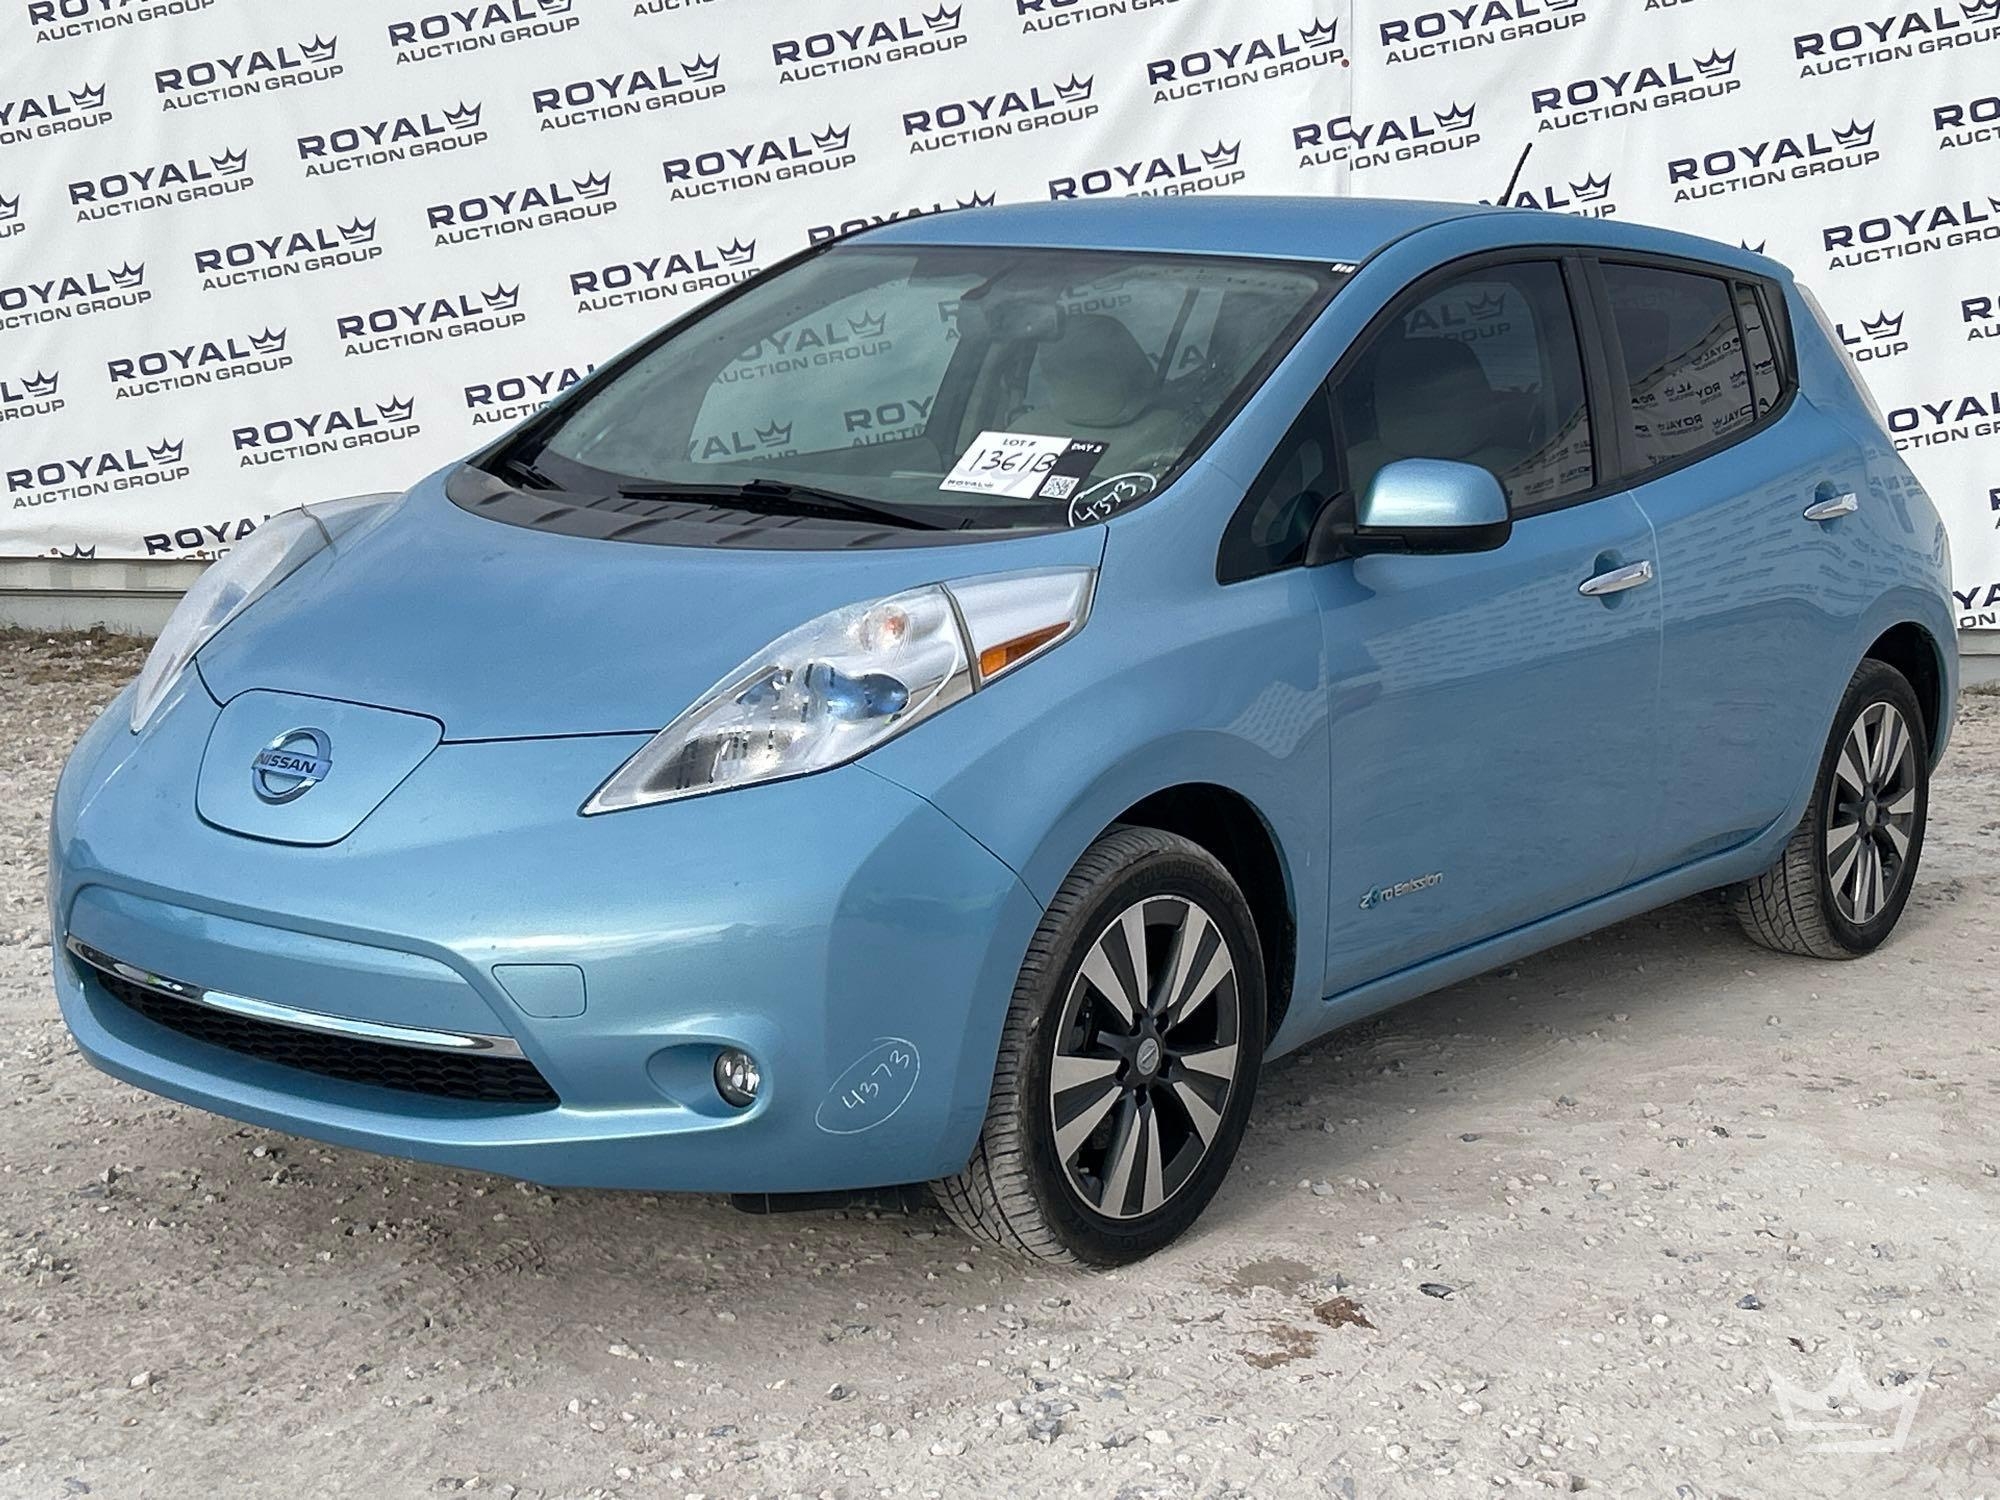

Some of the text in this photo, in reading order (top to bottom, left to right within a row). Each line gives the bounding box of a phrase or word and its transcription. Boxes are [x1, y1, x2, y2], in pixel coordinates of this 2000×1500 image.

[37, 12, 133, 43] AUCTION
[388, 0, 537, 47] ROYAL
[1023, 1, 1126, 34] AUCTION
[1380, 0, 1540, 46] ROYAL
[1386, 13, 1586, 65] AUCTION GROUP
[1794, 7, 1960, 59] ROYAL
[397, 17, 579, 65] AUCTION GROUP
[772, 17, 923, 66] ROYAL
[780, 35, 967, 84] AUCTION GROUP
[1147, 33, 1300, 85] ROYAL
[1800, 45, 1912, 78] AUCTION
[155, 47, 301, 93] ROYAL
[163, 65, 343, 111] AUCTION GROUP
[533, 66, 682, 113] ROYAL
[1154, 49, 1343, 104] AUCTION GROUP
[1532, 62, 1694, 114] ROYAL
[0, 95, 71, 126] YAL
[37, 112, 112, 137] GROUP
[541, 84, 725, 131] AUCTION GROUP
[903, 87, 1055, 136] ROYAL
[1538, 80, 1741, 133] AUCTION GROUP
[297, 114, 445, 159] ROYAL
[910, 105, 1098, 154] AUCTION GROUP
[1299, 133, 1480, 171] AUCION GROUP
[1940, 126, 2000, 150] AUCT
[306, 132, 488, 177] AUCTION GROUP
[663, 137, 812, 183] ROYAL
[1049, 153, 1201, 200] ROYAL
[1668, 133, 1832, 184] ROYAL
[1674, 151, 1879, 203] AUCTION GROUP
[69, 160, 212, 205] ROYAL
[77, 177, 254, 223] AUCTION GROUP
[671, 155, 855, 201] AUCTION GROUP
[1165, 171, 1245, 197] GROUP
[427, 183, 574, 229] ROYAL
[435, 201, 617, 247] AUCTION GROUP
[1823, 201, 1989, 252] ROYAL
[195, 229, 339, 273] ROYAL
[203, 247, 382, 291] AUCTION GROUP
[1829, 226, 2000, 270] AUCTION GRO
[0, 273, 110, 311] OYAL
[570, 250, 719, 296] ROYAL
[0, 291, 151, 330] CTION GROUP
[337, 295, 483, 339] ROYAL
[578, 284, 677, 313] AUCTION
[345, 313, 525, 357] AUCTION GROUP
[813, 341, 892, 366] GROUP
[1848, 342, 1908, 362] OUP
[107, 338, 250, 382] ROYAL
[116, 356, 293, 399] AUCTION GROUP
[232, 407, 378, 450] ROYAL
[844, 395, 934, 432] ROY
[240, 425, 420, 467] AUCTION GROUP
[1002, 438, 1027, 446] LOT
[1894, 427, 1969, 451] CTION
[6, 449, 149, 492] ROYAL
[13, 467, 189, 509] AUCTION GROUP
[1074, 480, 1137, 523] 4373
[143, 515, 270, 555] ROYA
[260, 752, 317, 774] NISSAN
[842, 1050, 910, 1109] 4373
